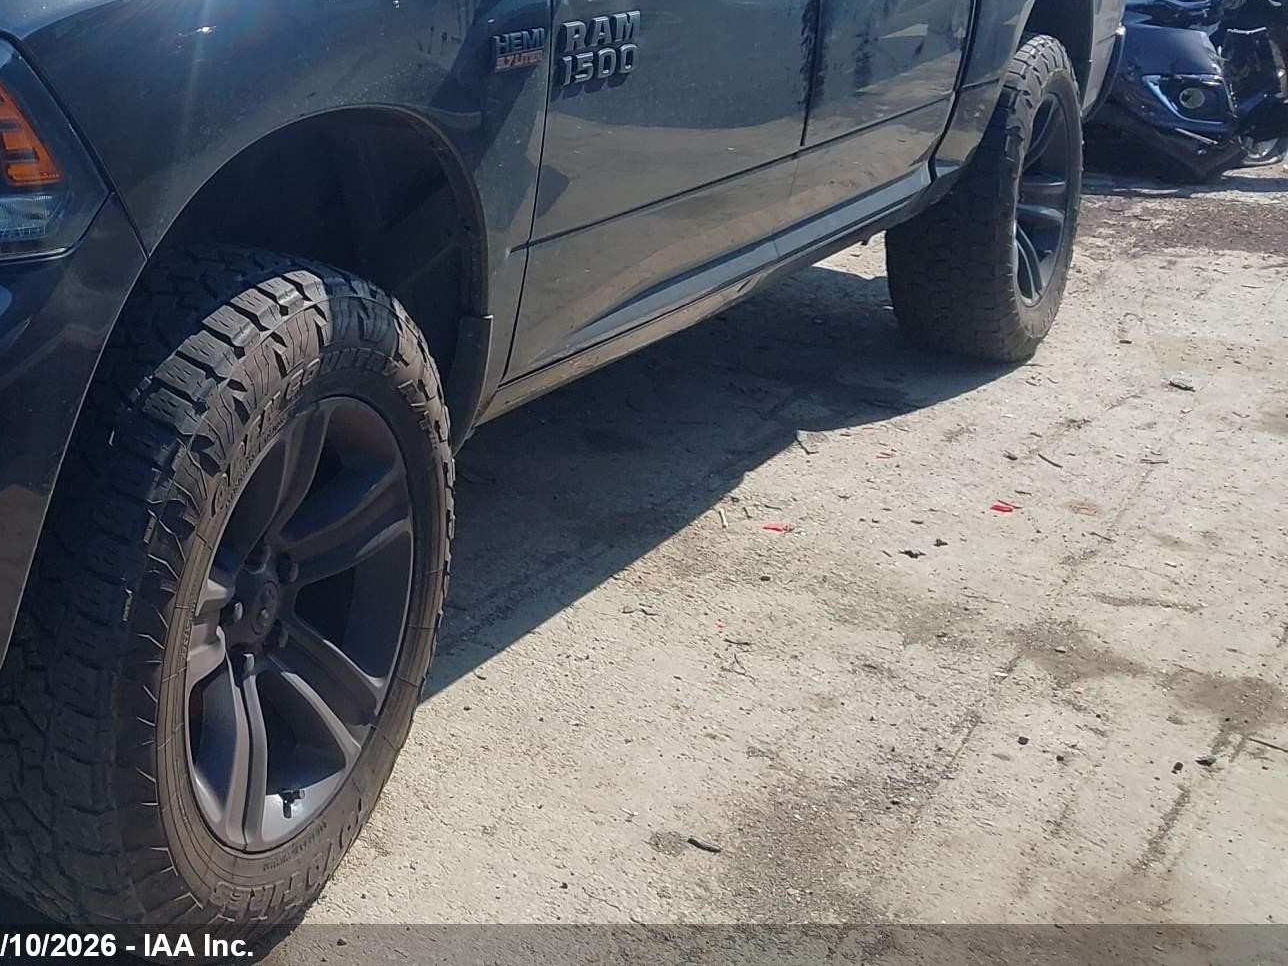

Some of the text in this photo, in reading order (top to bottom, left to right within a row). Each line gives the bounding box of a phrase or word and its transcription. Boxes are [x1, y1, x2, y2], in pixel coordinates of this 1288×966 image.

[492, 27, 545, 57] HEMI
[562, 9, 642, 53] RAM
[561, 42, 640, 86] 1500
